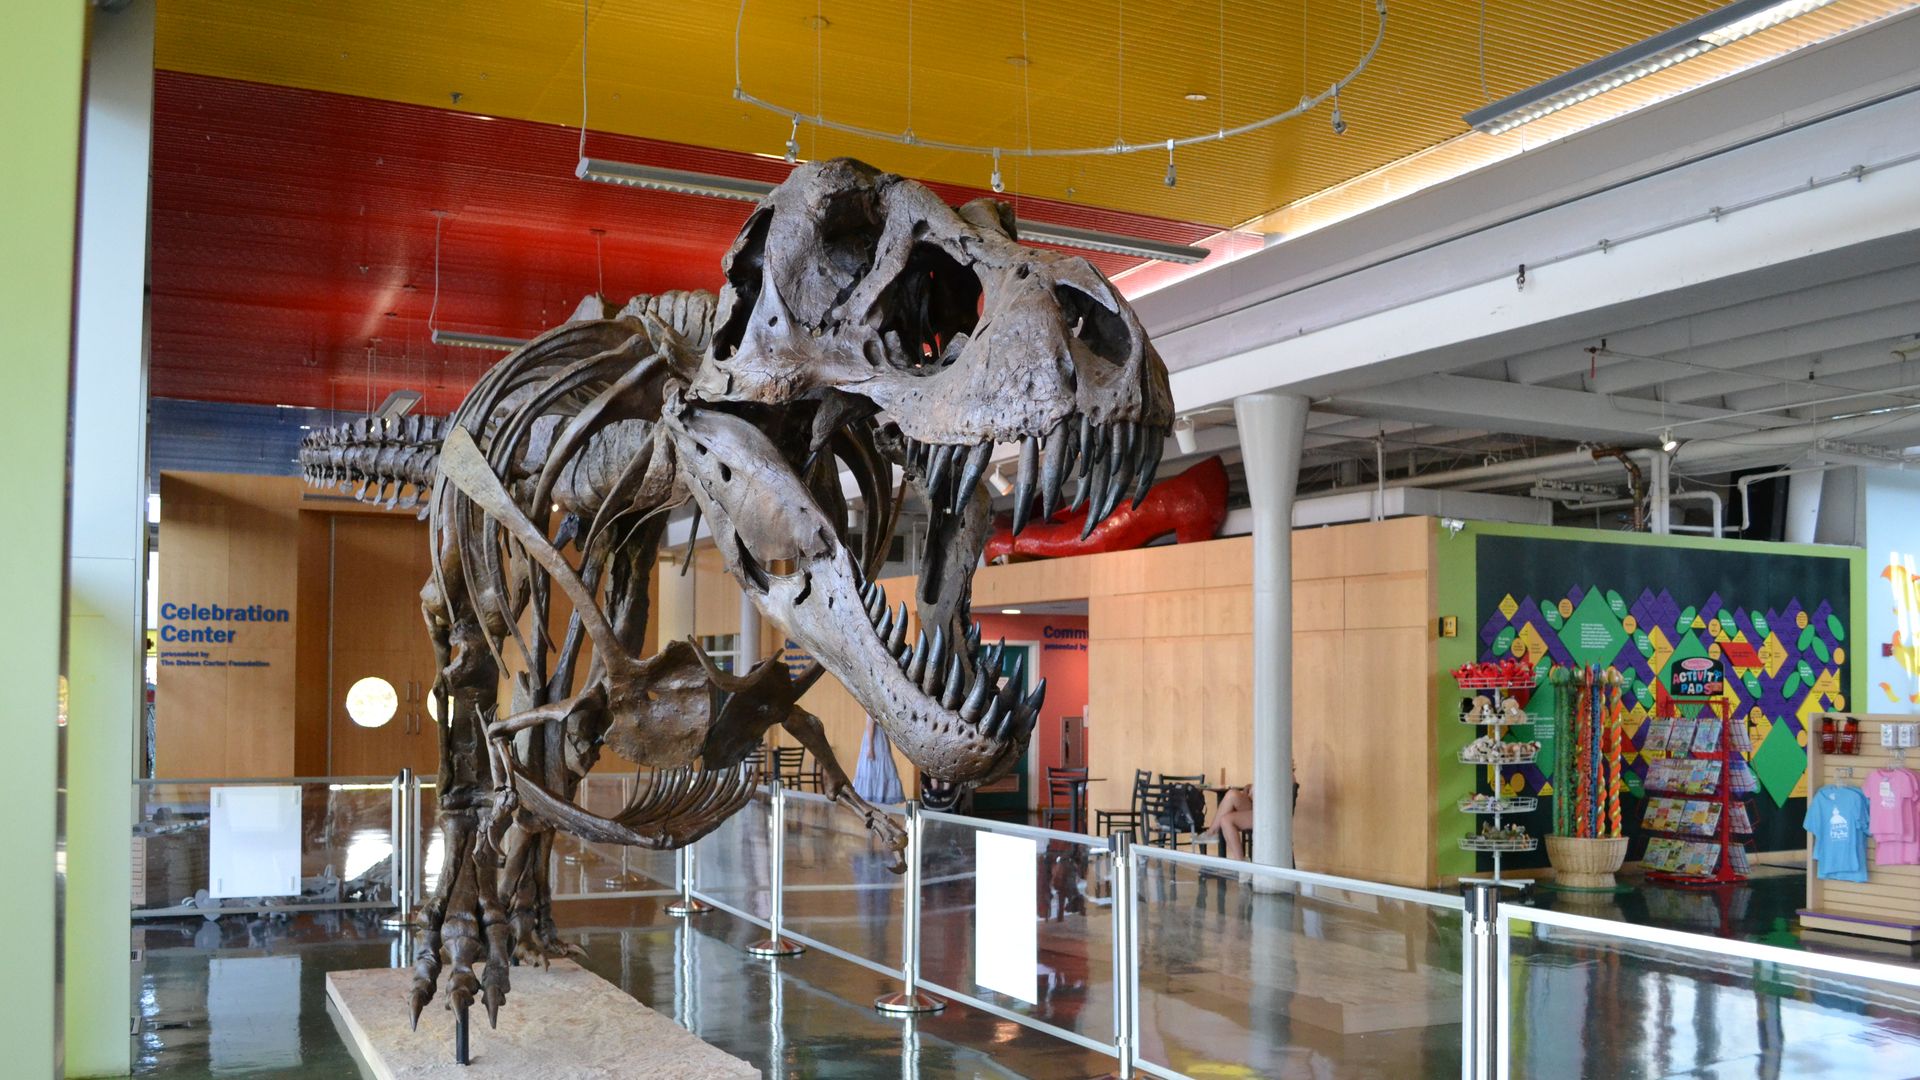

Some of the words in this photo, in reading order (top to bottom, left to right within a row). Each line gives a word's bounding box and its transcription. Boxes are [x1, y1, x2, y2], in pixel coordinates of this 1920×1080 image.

[161, 602, 289, 622] Celebration
[161, 624, 236, 643] Center
[1044, 625, 1089, 639] Comm
[1672, 669, 1722, 685] ACTIVITY
[1680, 683, 1713, 695] PADS
